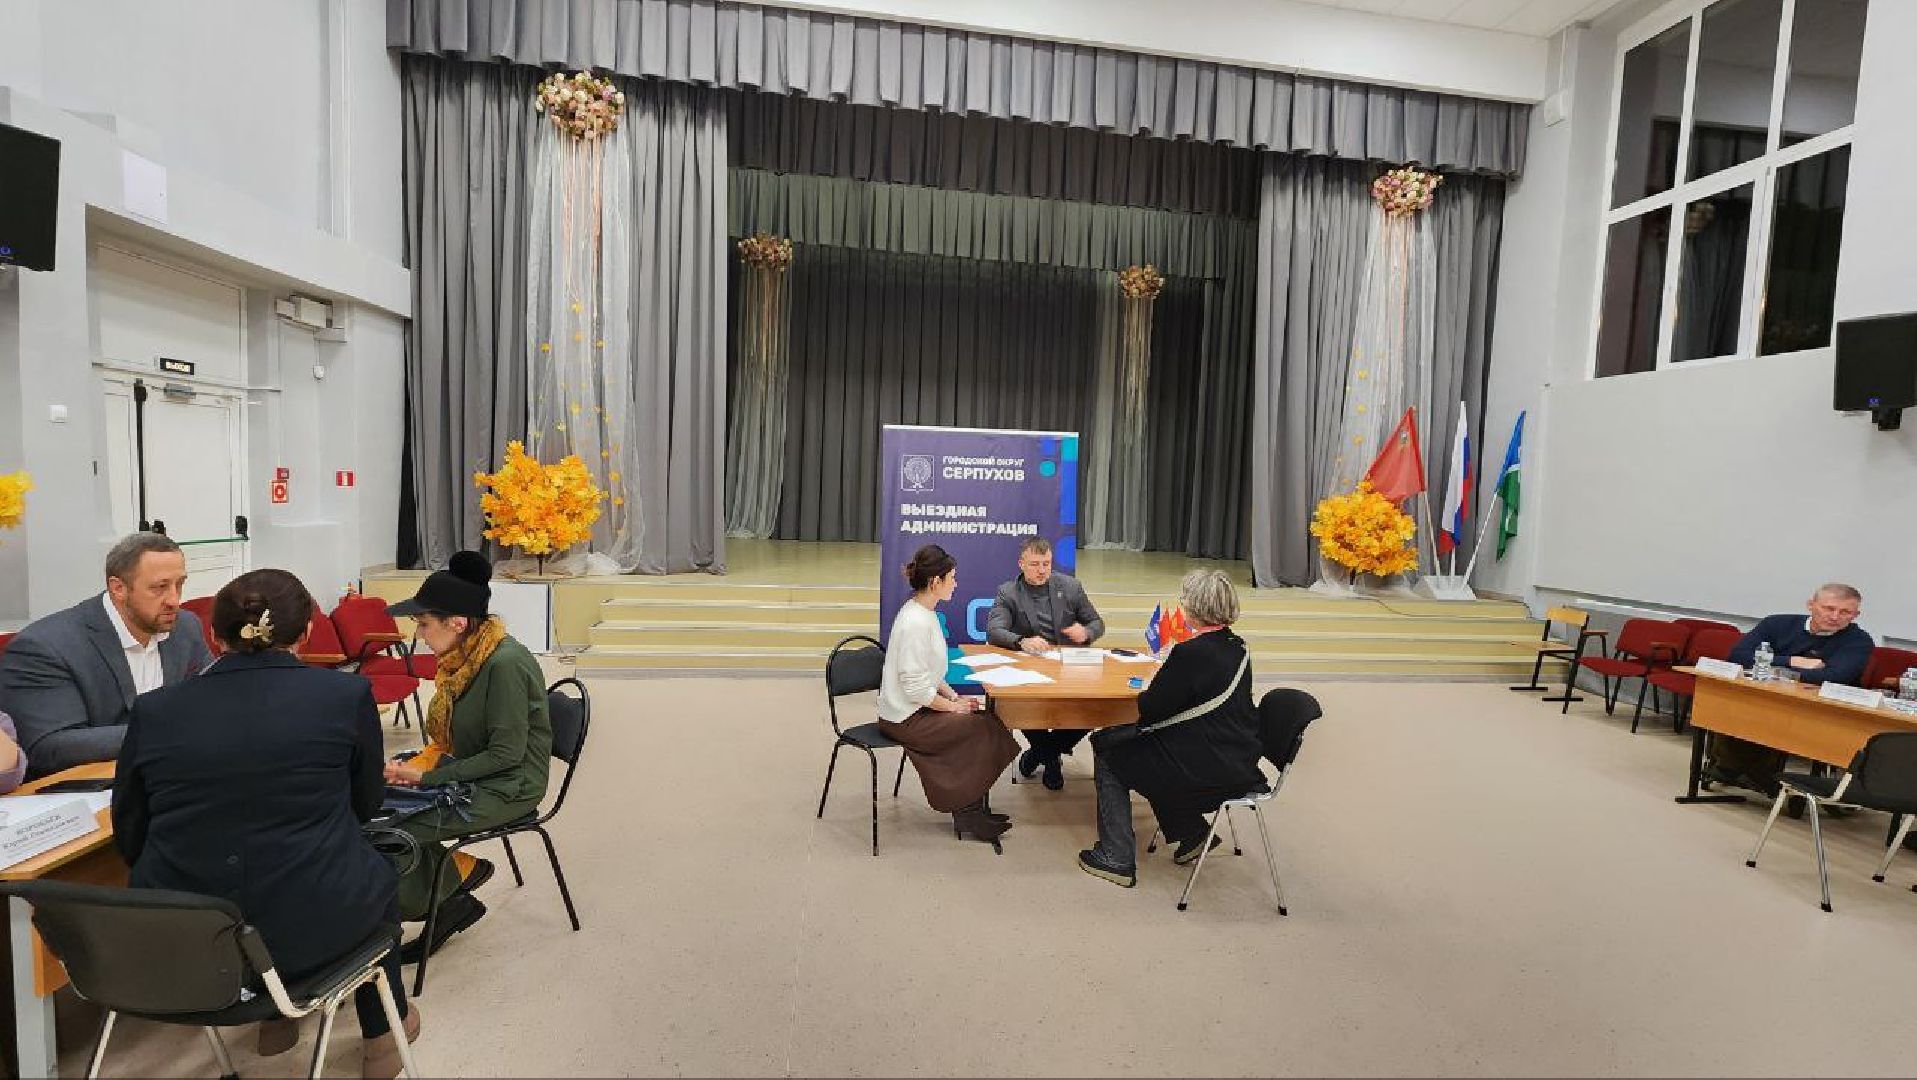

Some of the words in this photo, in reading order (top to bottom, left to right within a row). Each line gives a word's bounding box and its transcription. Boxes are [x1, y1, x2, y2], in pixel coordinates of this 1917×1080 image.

[942, 455, 995, 466] ГОРОДСКОЙ
[996, 458, 1025, 467] ОКРУГ
[942, 466, 1025, 481] СЕРПУХОВ
[900, 503, 987, 518] ВЫЕЗДНАЯ
[900, 520, 1038, 537] АДМИНИСТРАЦИЯ
